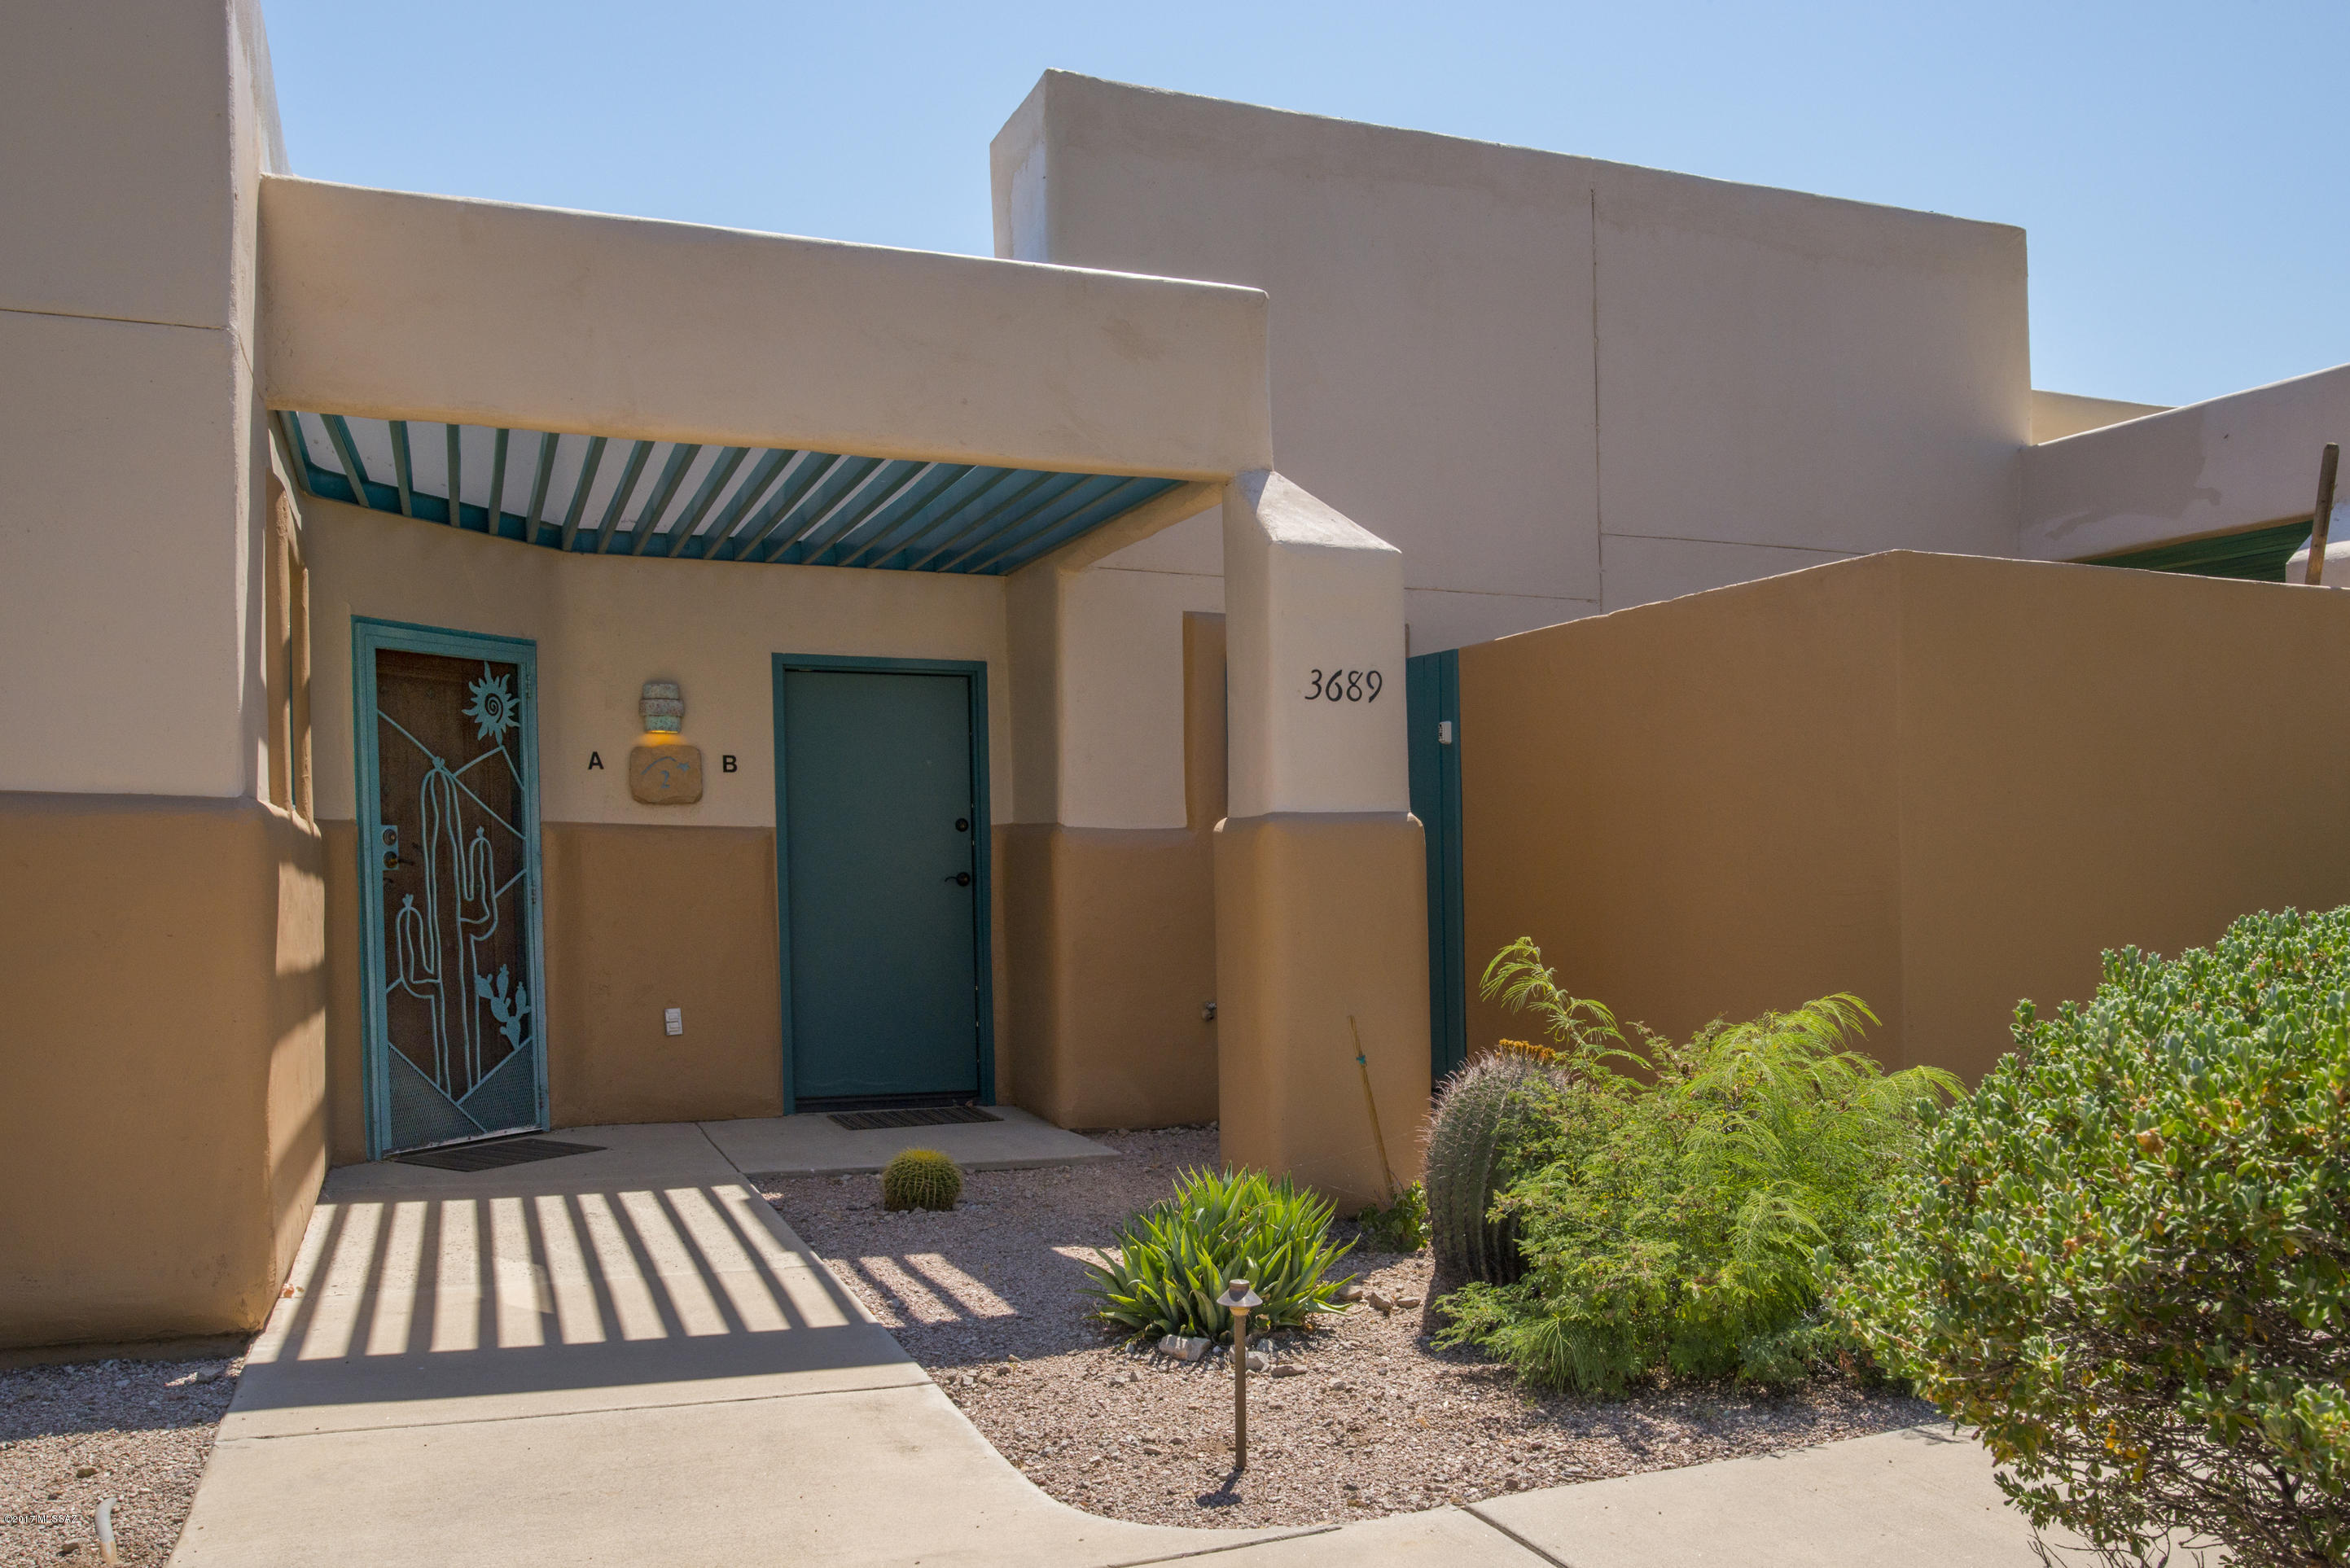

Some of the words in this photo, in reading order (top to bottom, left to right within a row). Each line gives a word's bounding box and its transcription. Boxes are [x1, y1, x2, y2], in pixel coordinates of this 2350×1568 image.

[1304, 668, 1383, 703] 3689
[587, 751, 604, 770] A
[721, 755, 738, 773] B
